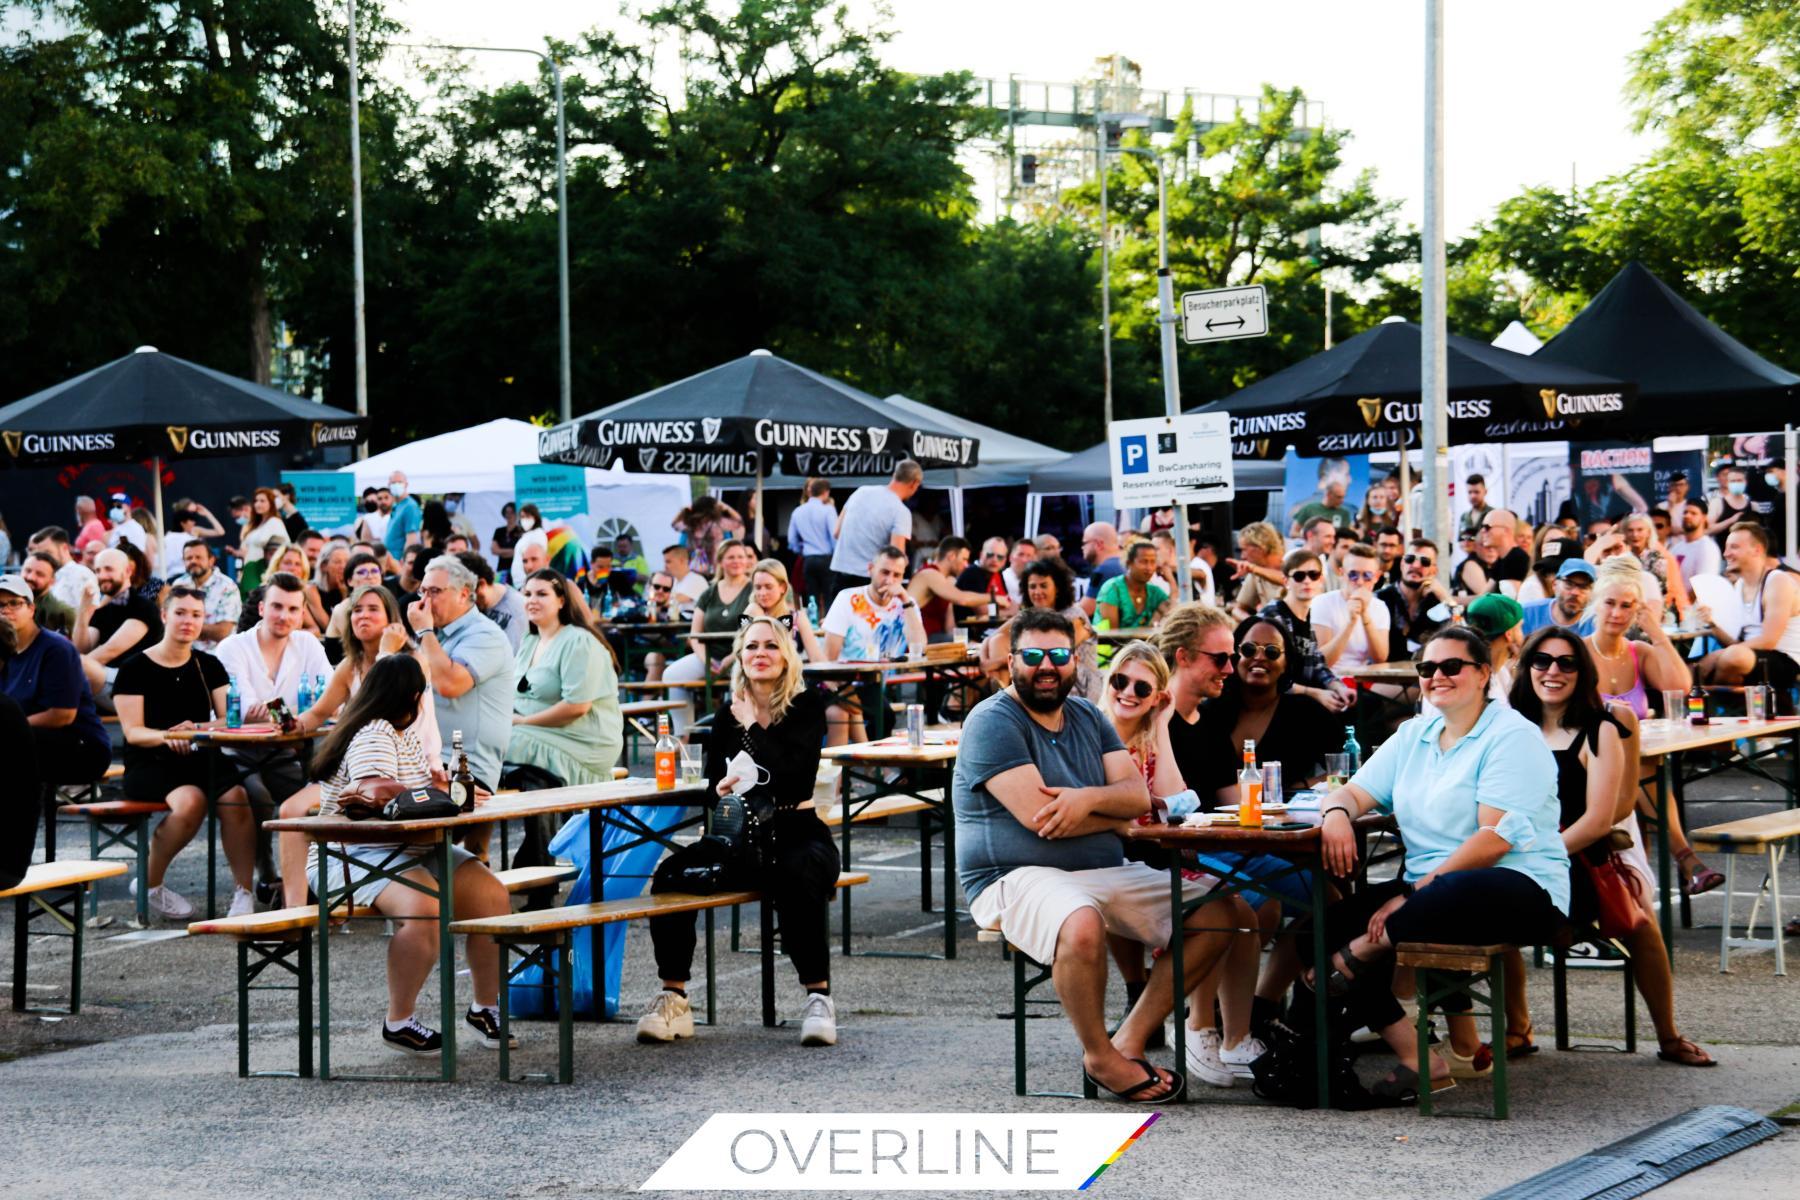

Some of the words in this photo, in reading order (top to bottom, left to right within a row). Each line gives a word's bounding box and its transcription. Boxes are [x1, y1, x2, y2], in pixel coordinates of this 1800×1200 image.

[1188, 296, 1260, 311] Besucherparkplatz
[1384, 399, 1491, 422] GUINESS
[1557, 394, 1623, 414] GUINNESS
[190, 429, 281, 449] GUINNESS
[597, 419, 695, 446] GUINNESS
[755, 418, 861, 452] GUINNESS
[23, 434, 115, 453] GUINNESS
[913, 430, 960, 463] GUINNESS
[1126, 444, 1143, 466] P
[1158, 461, 1222, 473] BwCarsharing
[1122, 480, 1178, 489] Reservierter
